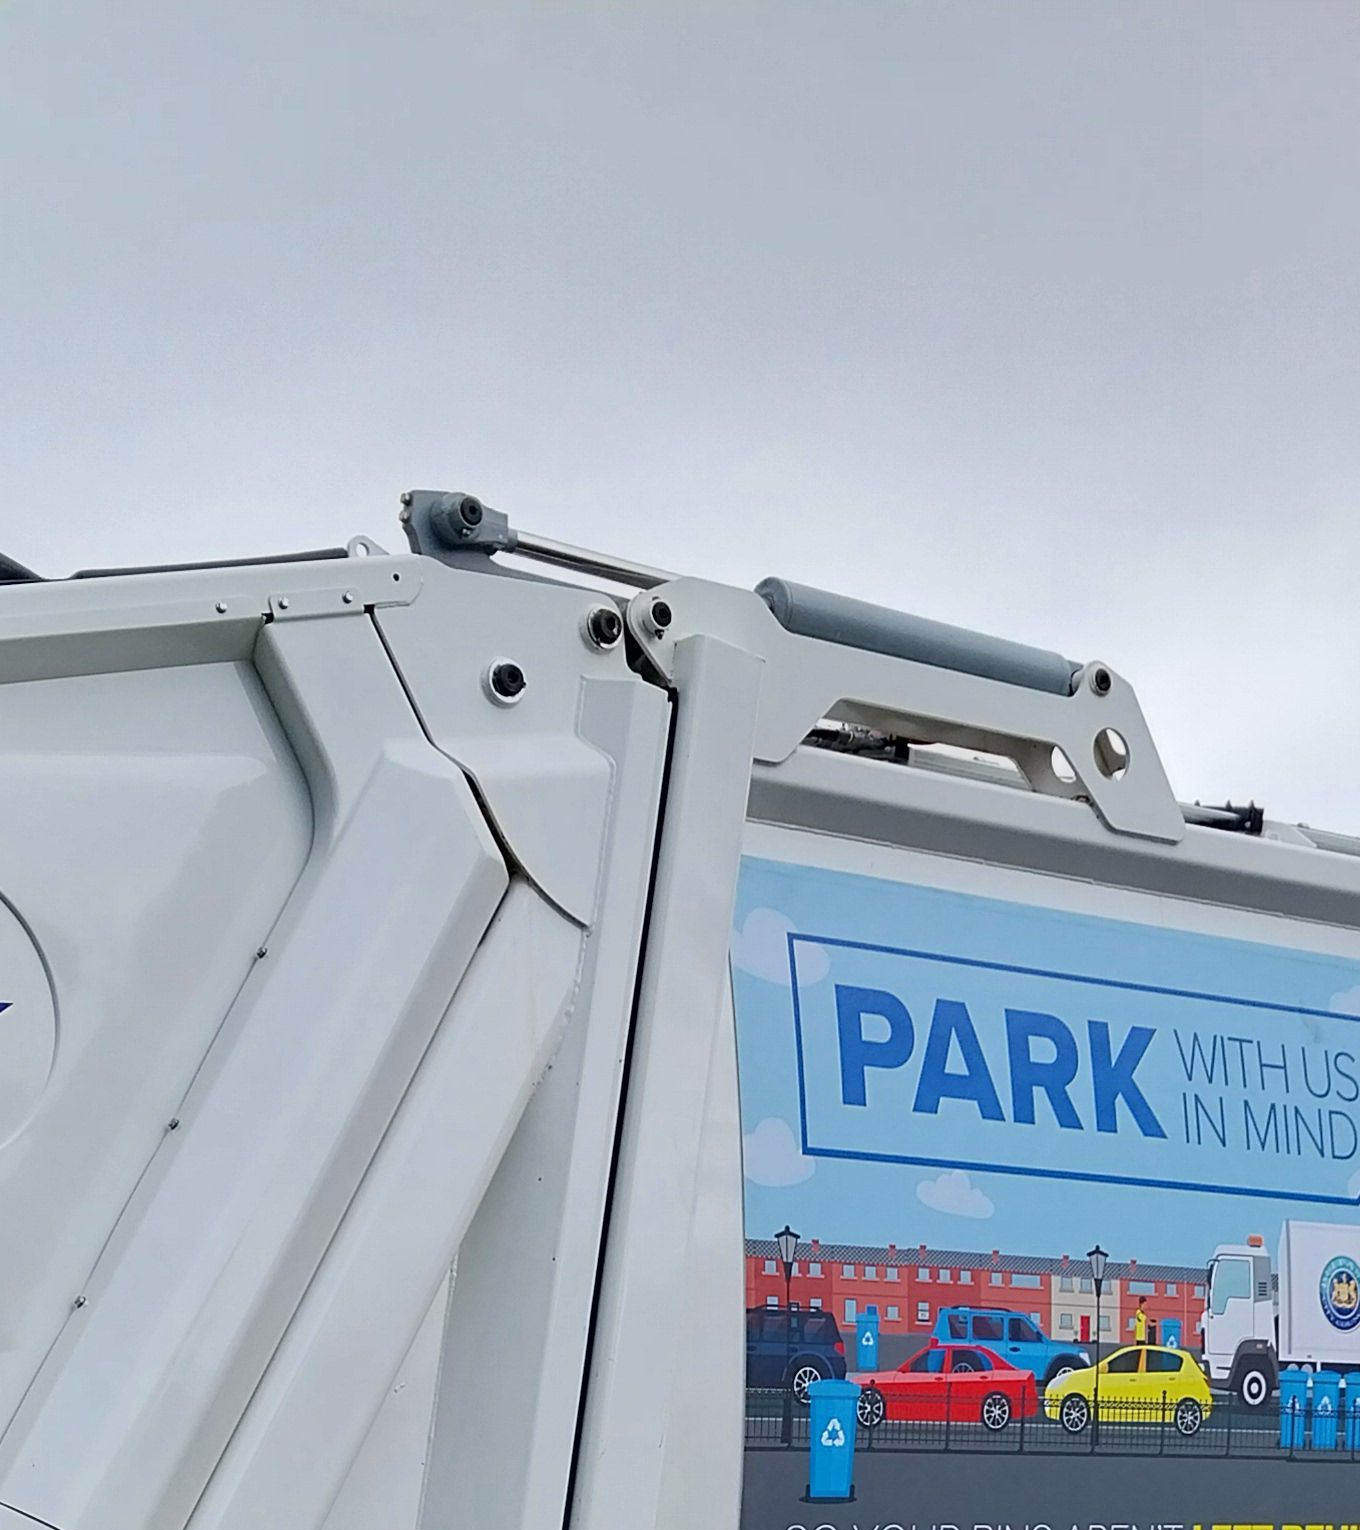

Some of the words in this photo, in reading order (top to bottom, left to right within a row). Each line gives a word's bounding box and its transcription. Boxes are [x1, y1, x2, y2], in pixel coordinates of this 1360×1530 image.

[834, 983, 1169, 1140] PARK
[1173, 1028, 1290, 1094] WITH
[1300, 1045, 1360, 1102] US
[1182, 1091, 1227, 1148] IN
[1243, 1098, 1359, 1161] MIND
